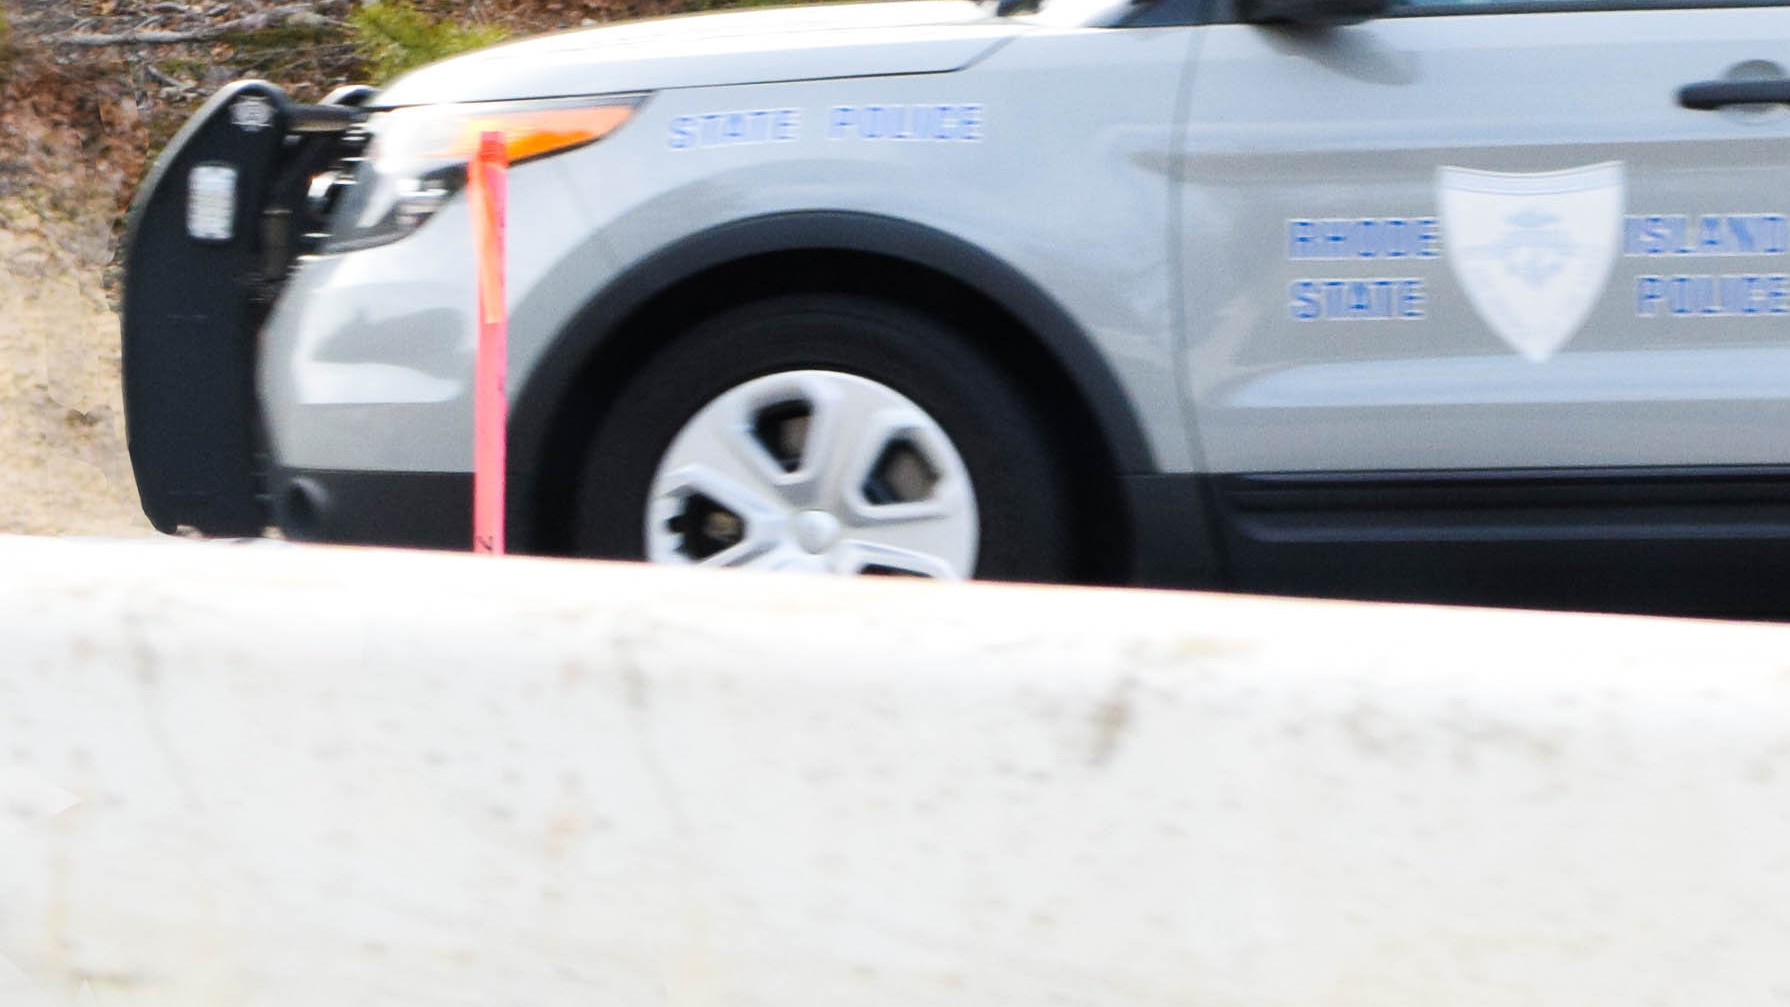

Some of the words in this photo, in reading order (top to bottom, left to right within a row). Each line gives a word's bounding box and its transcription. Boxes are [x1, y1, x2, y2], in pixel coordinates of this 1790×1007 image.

[669, 108, 800, 151] STATE
[828, 104, 984, 142] POLICE
[1288, 217, 1440, 260] RHODE
[1624, 213, 1790, 257] ISLAND
[1289, 277, 1427, 321] STATE
